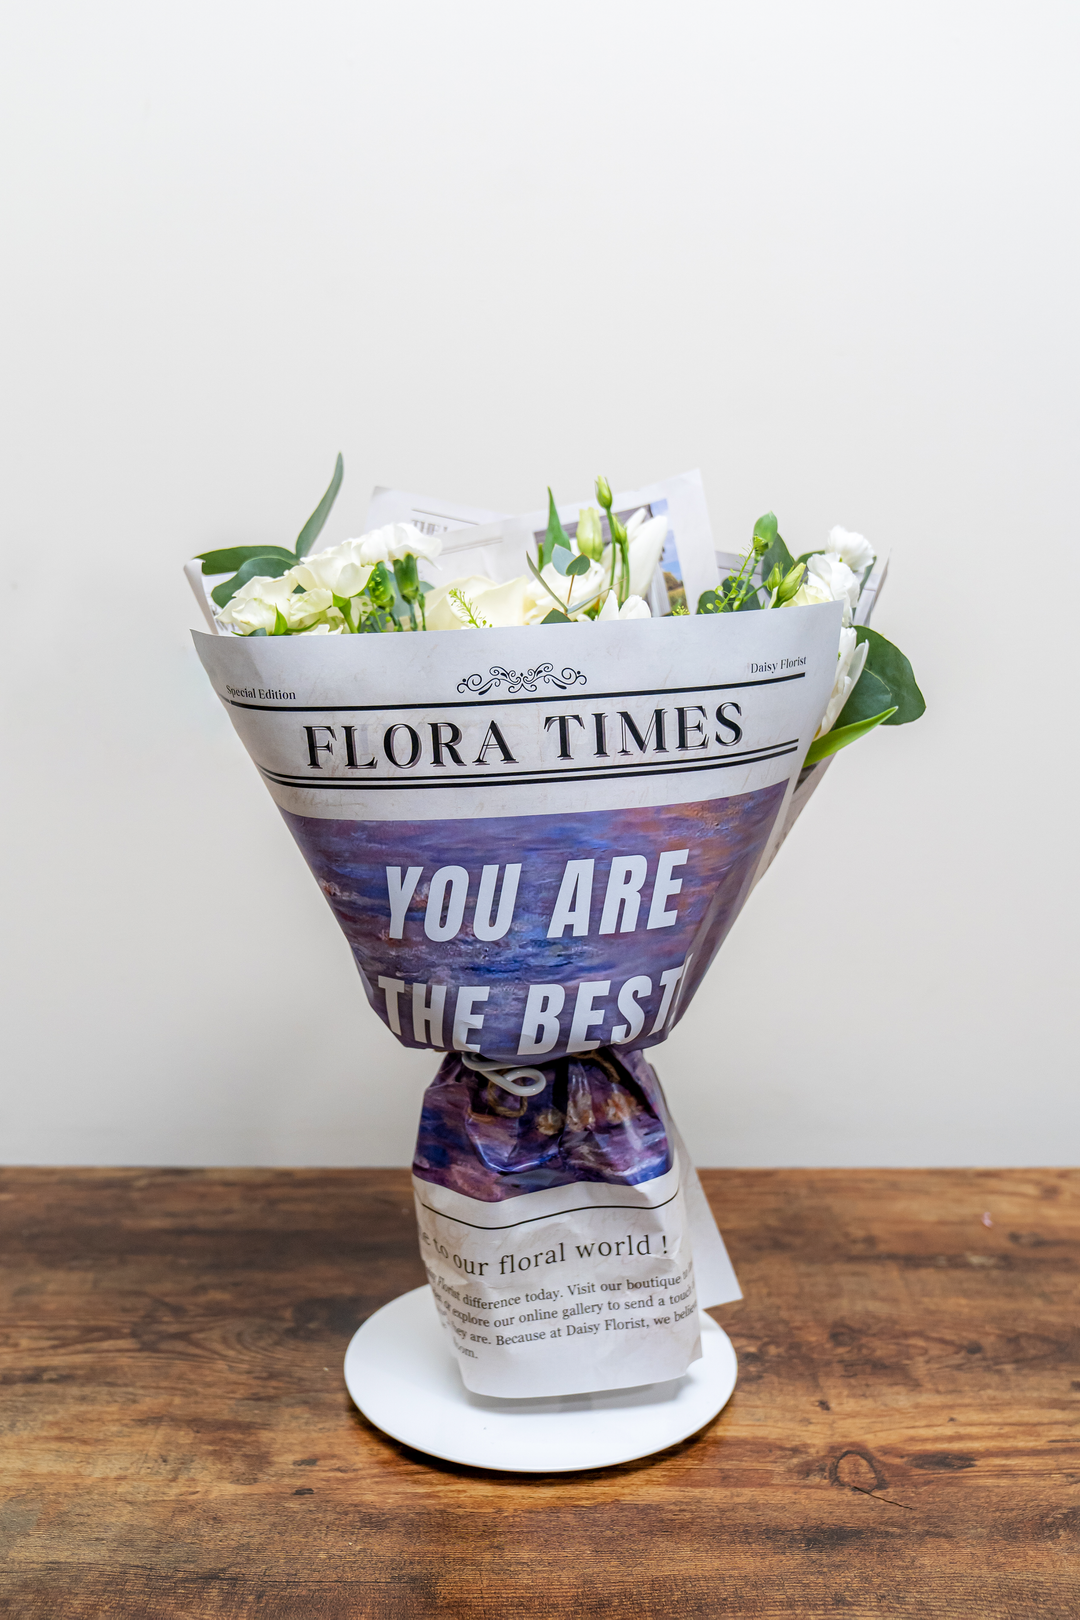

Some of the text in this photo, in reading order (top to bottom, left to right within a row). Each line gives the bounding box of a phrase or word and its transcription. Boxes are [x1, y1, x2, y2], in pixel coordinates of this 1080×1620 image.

[751, 656, 807, 673] Daisy Florist
[226, 684, 296, 700] Special Edition
[303, 701, 743, 769] FLORA TIMES
[386, 849, 689, 942] YOU ARE
[378, 975, 490, 1052] THE
[433, 1238, 448, 1259] to
[453, 1254, 489, 1276] our
[499, 1242, 566, 1275] floral
[575, 1234, 651, 1258] world
[662, 1235, 668, 1254] !
[438, 1276, 461, 1301] Florist
[463, 1294, 521, 1310] difference
[525, 1288, 563, 1301] today.
[567, 1282, 596, 1296] Visit
[600, 1283, 622, 1292] our
[626, 1276, 681, 1290] boutique
[452, 1307, 490, 1327] explore
[493, 1316, 515, 1328] our
[518, 1309, 558, 1323] online
[562, 1302, 603, 1320] gallery
[607, 1300, 620, 1311] to
[624, 1295, 654, 1310] send
[658, 1297, 665, 1306] a
[470, 1332, 491, 1345] are.
[496, 1331, 546, 1346] Because
[550, 1328, 562, 1338] at
[566, 1322, 601, 1336] Daisy
[604, 1318, 650, 1330] Florist,
[653, 1317, 670, 1326] we
